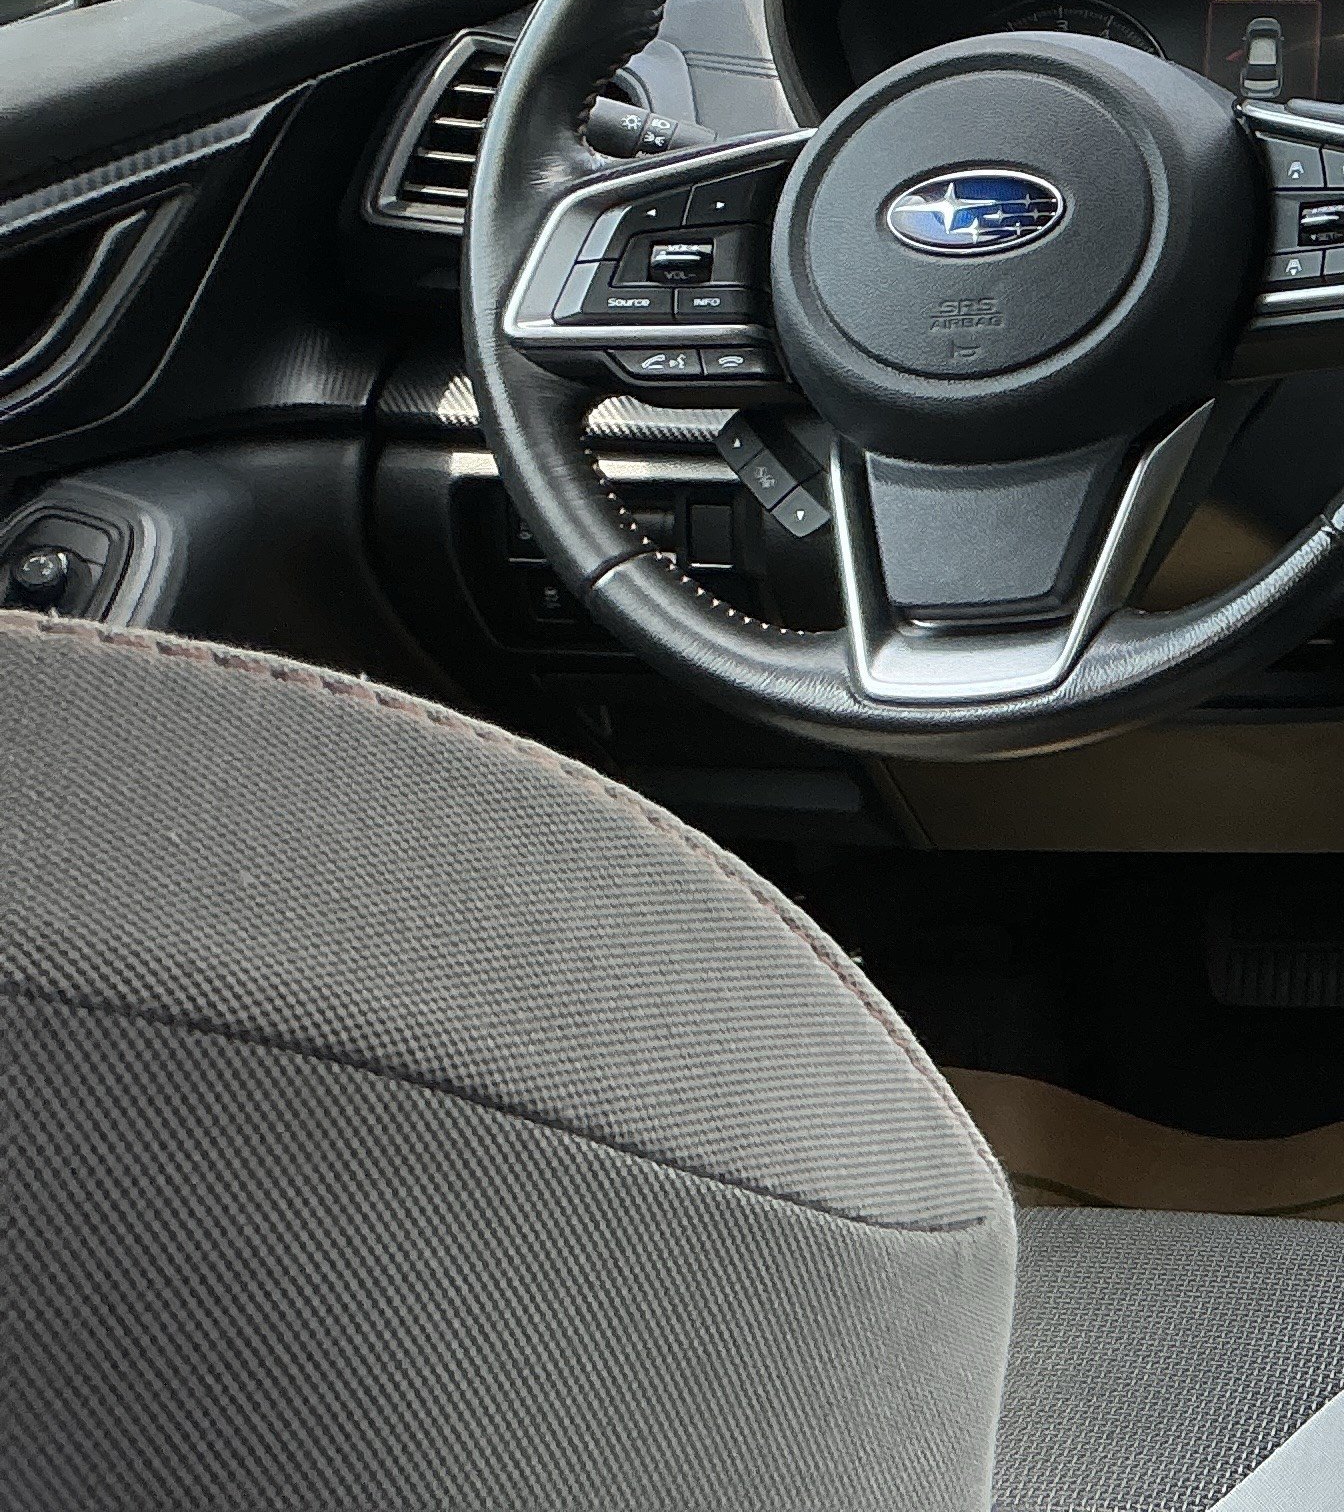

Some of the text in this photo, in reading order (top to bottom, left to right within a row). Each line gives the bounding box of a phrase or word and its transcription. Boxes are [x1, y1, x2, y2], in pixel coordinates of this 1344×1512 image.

[1056, 20, 1069, 31] 3
[607, 297, 650, 307] Source
[693, 297, 720, 307] INFO
[939, 297, 997, 315] SRS
[930, 316, 1004, 330] AIRBAG
